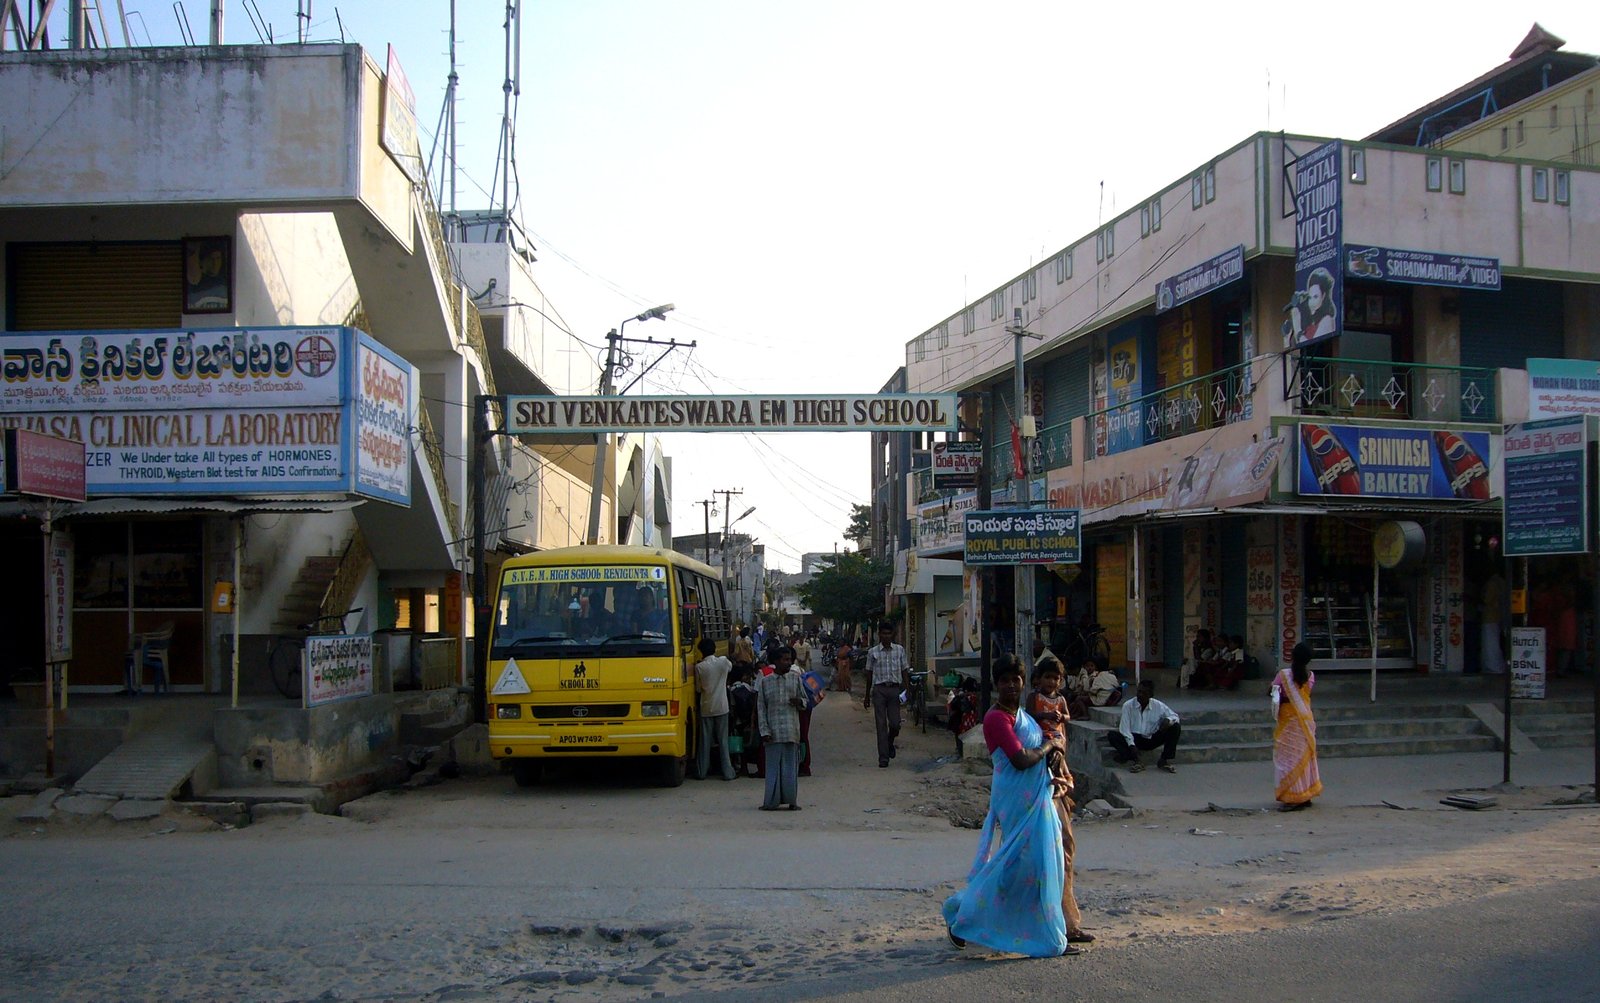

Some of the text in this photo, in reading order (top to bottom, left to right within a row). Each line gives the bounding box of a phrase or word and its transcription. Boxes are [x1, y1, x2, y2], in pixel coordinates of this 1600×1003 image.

[1297, 155, 1337, 194] DIGITAL
[1297, 180, 1337, 221] STUDIO
[1297, 209, 1337, 249] VIDEO
[1222, 257, 1241, 279] STUDIO
[1470, 267, 1498, 285] VIDEO
[0, 338, 73, 383] వాస్
[79, 336, 168, 389] క్లినికల్
[516, 399, 947, 427] SRI VENKATESWARA EM HIGH SCHOOL
[90, 414, 201, 448] CLINICAL
[205, 412, 341, 446] LABORATORY
[121, 452, 138, 464] We
[141, 452, 171, 464] Under
[174, 451, 198, 463] take
[203, 450, 215, 462] All
[218, 451, 248, 465] types
[251, 450, 263, 462] of
[1360, 437, 1430, 467] SRINIVASA
[166, 466, 205, 479] Western
[207, 466, 223, 478] Blot
[224, 466, 243, 478] test
[261, 466, 285, 477] AIDS
[1318, 456, 1356, 490] PEPSI
[1365, 472, 1428, 494] BAKERY
[1450, 462, 1488, 495] PEPSI
[967, 514, 1077, 536] రాయల్ పబ్లిక్ స్కూల్
[967, 537, 1078, 552] ROYAL PUBLIC SCHOOL
[967, 553, 987, 561] Behind
[988, 553, 1020, 562] Panchayat
[550, 569, 569, 581] HIGH
[570, 568, 601, 580] SCHOOL
[603, 568, 648, 580] RENIGUNTA
[655, 568, 661, 579] 1
[56, 558, 65, 652] LABORATORY
[1513, 660, 1540, 670] BSNL
[560, 679, 598, 689] SCHOOL BUS
